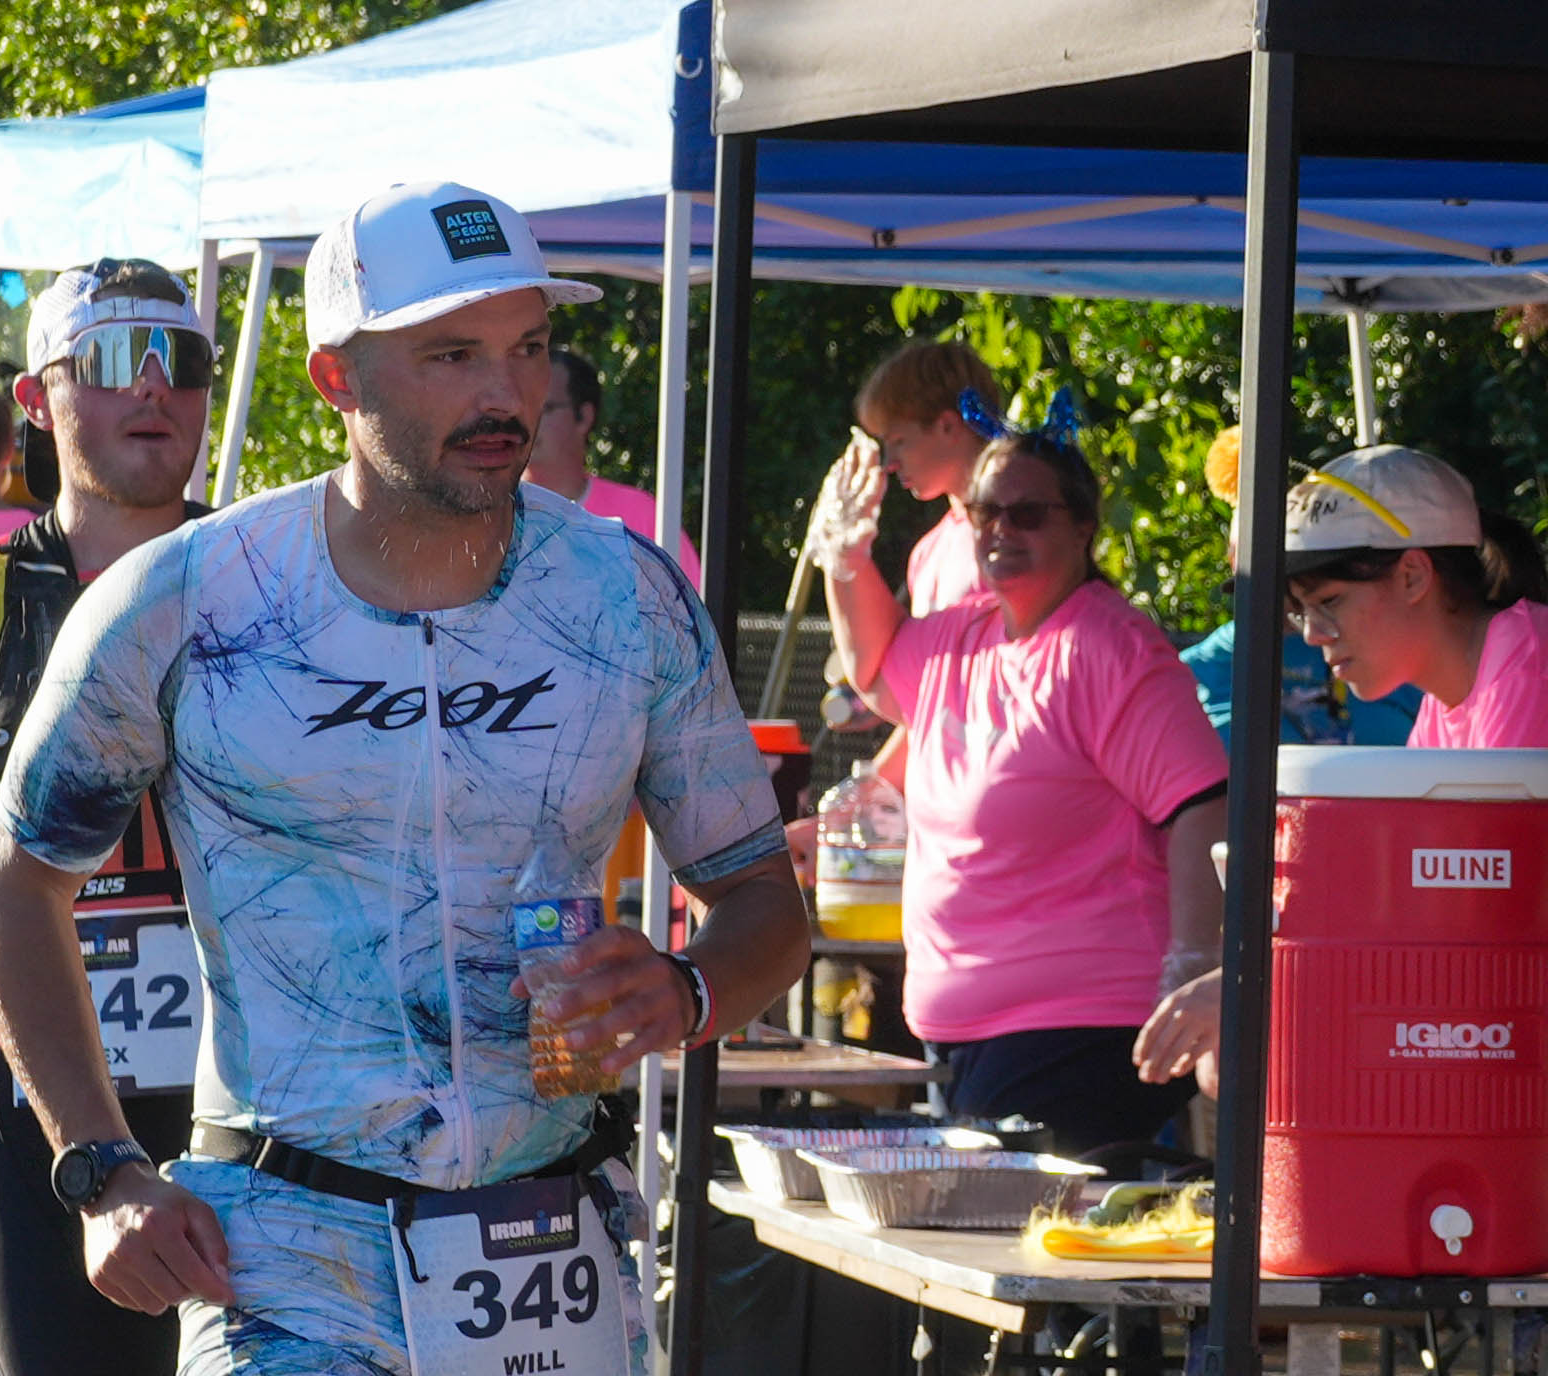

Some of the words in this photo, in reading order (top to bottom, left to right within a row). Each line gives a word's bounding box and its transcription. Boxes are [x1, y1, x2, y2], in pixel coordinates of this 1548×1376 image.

[446, 211, 493, 229] ALTER
[461, 224, 486, 237] EGO
[459, 234, 496, 245] RUNNING
[1419, 856, 1505, 881] ULINE
[89, 974, 192, 1032] 42
[1395, 1022, 1511, 1049] IGLOO
[1427, 1049, 1480, 1059] DRINKING
[1481, 1049, 1516, 1060] WATER
[489, 1209, 574, 1241] IRONMAN
[507, 1232, 573, 1249] CHATTANOOGA
[453, 1254, 600, 1340] 349
[503, 1349, 565, 1376] WILL
